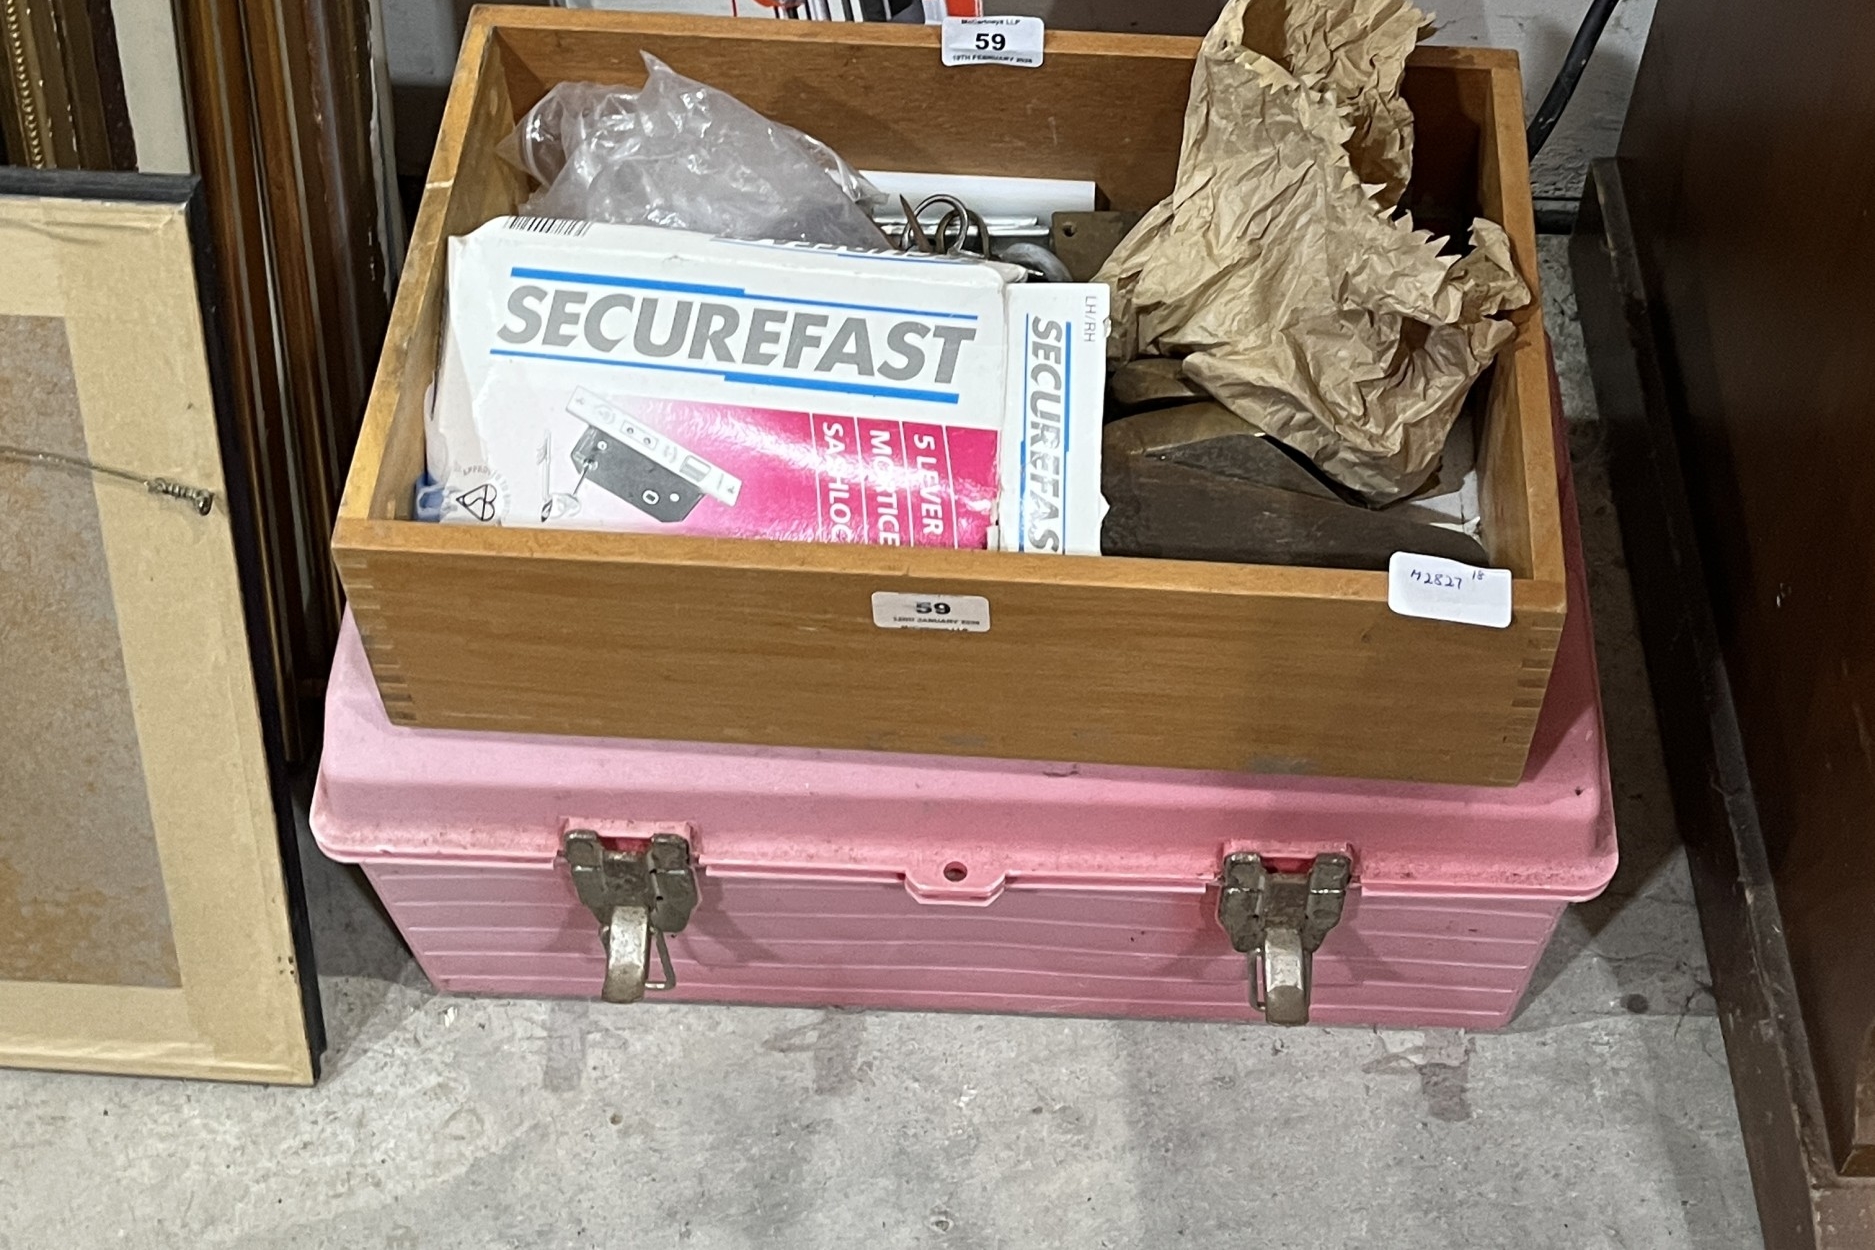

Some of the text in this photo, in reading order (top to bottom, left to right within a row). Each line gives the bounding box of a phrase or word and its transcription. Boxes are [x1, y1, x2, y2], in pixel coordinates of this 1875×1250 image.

[975, 33, 1006, 52] 59
[497, 284, 978, 385] SECUREFAST
[1084, 296, 1097, 342] LH/RH
[822, 422, 852, 543] SASHLOC
[913, 434, 944, 535] 5 LEVER
[1028, 315, 1063, 553] SECUREFAS
[869, 430, 900, 547] MORTICE
[916, 602, 951, 615] 59
